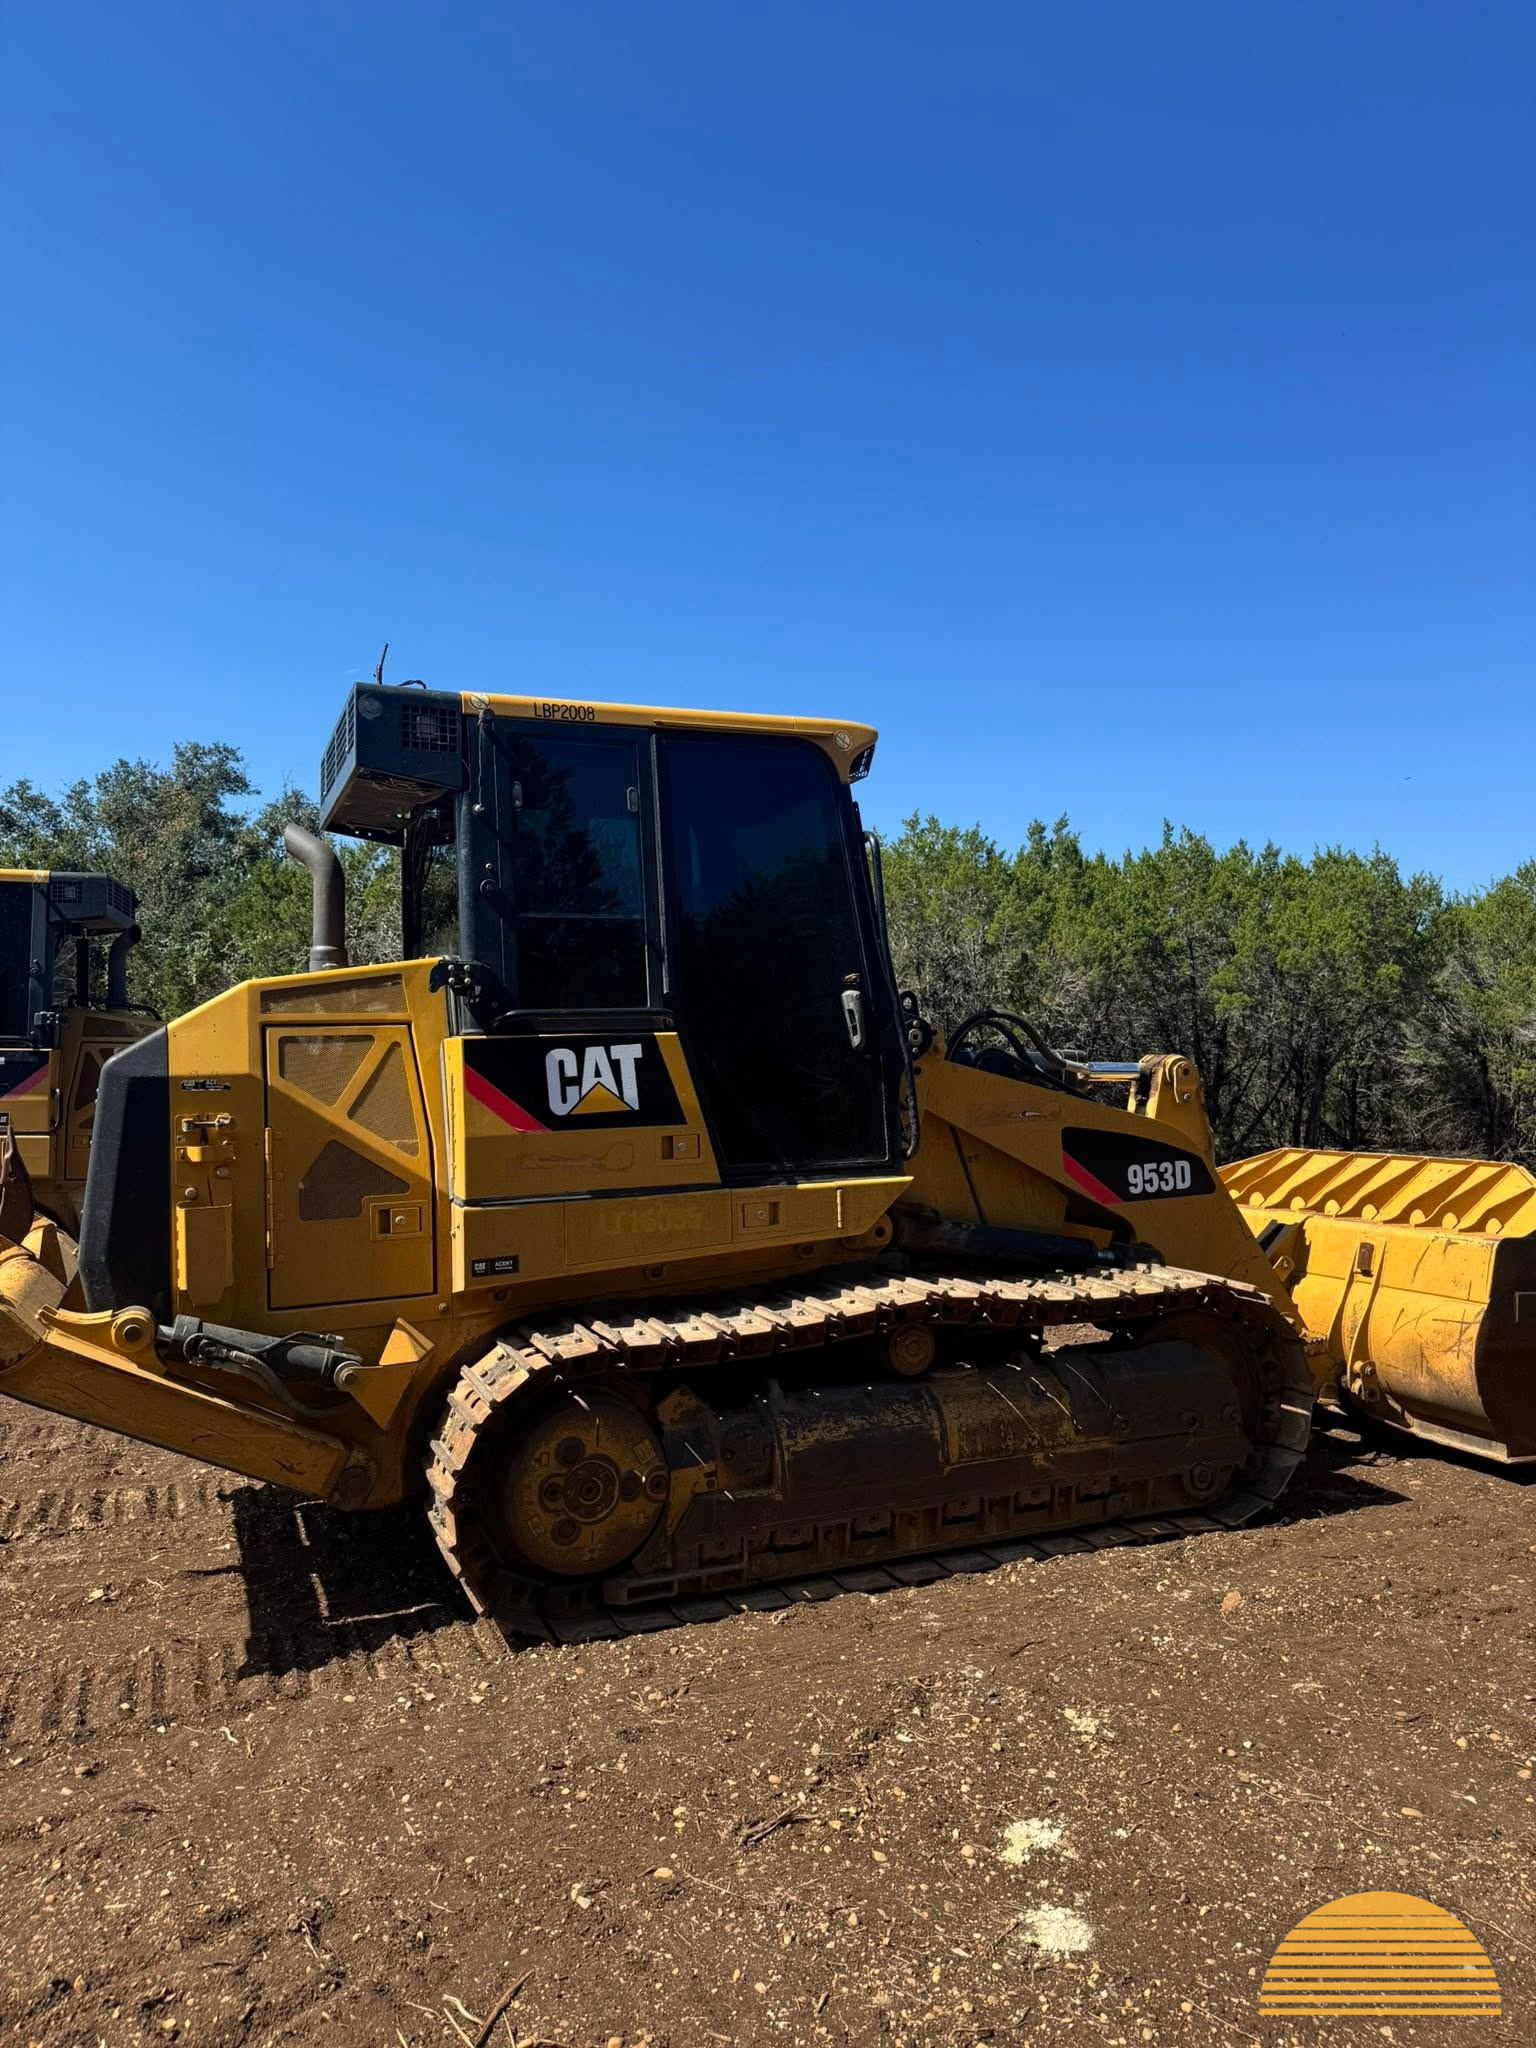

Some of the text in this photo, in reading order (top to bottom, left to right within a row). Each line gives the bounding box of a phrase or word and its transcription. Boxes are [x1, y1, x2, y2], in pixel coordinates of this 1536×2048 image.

[533, 702, 595, 721] LBP2008
[545, 1043, 643, 1116] CAT
[1127, 1160, 1192, 1195] 953D
